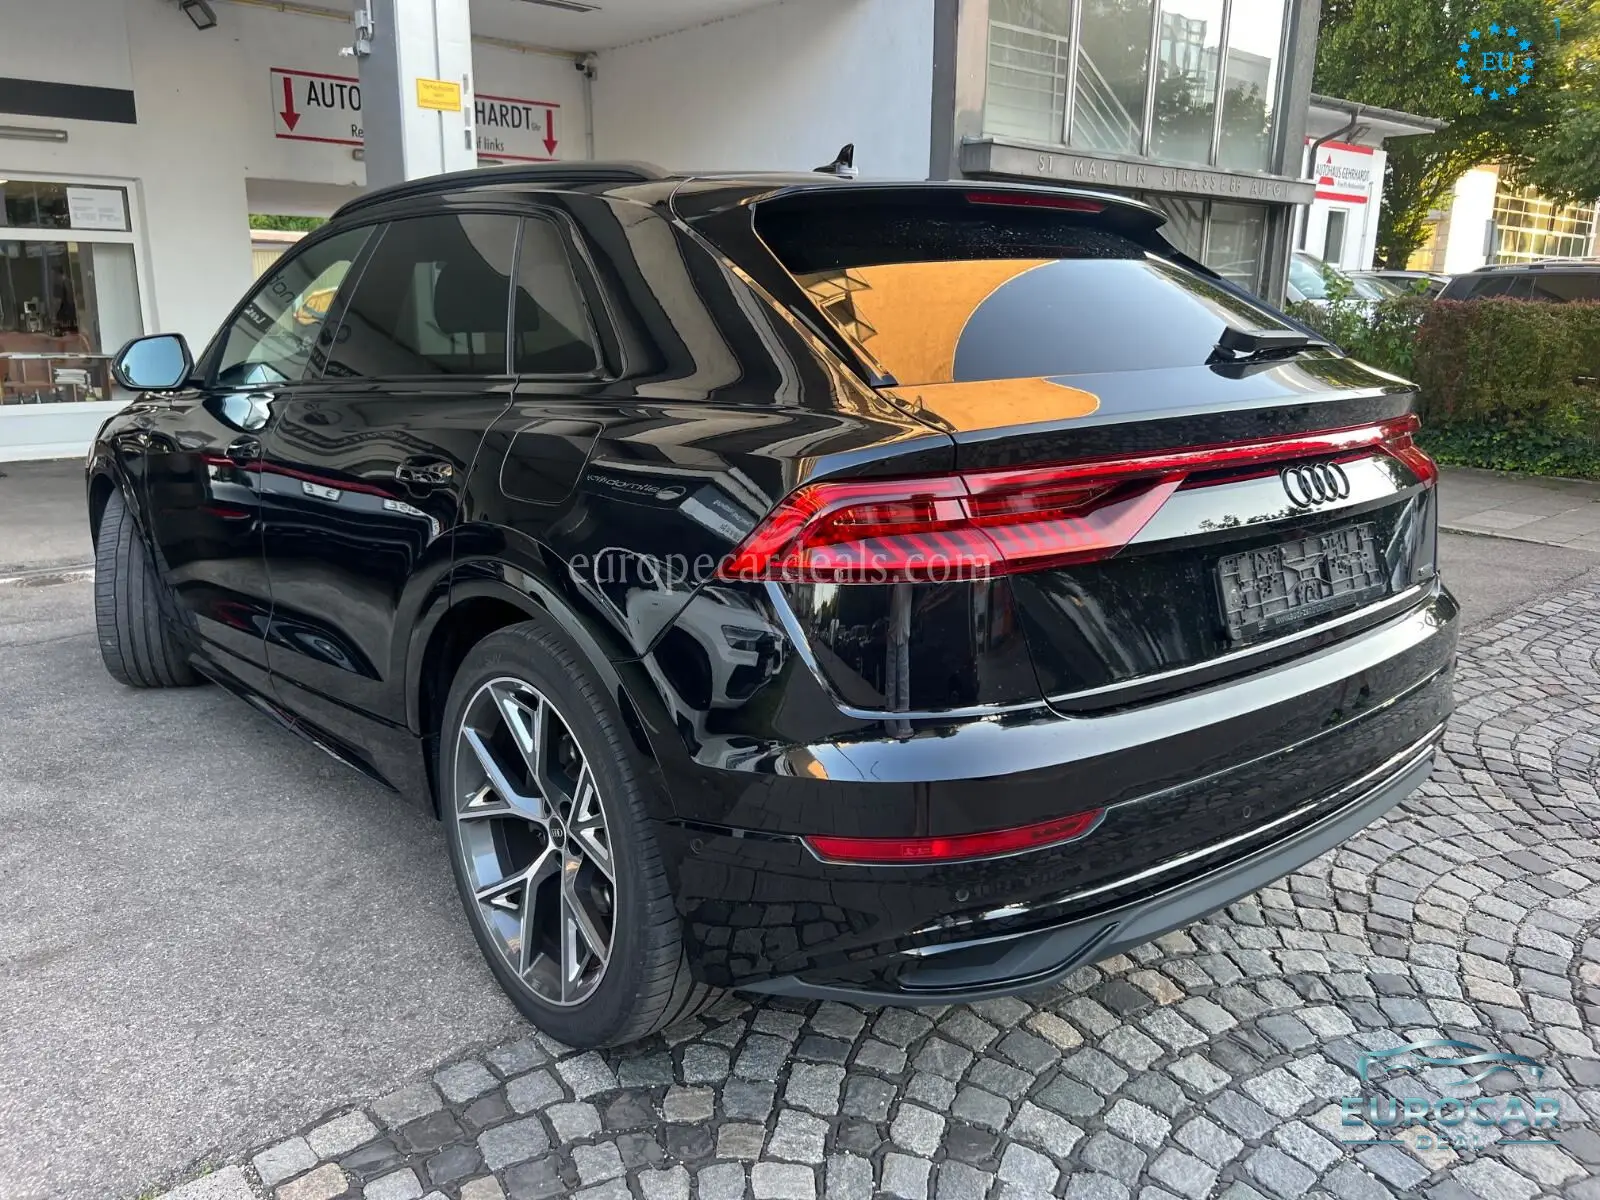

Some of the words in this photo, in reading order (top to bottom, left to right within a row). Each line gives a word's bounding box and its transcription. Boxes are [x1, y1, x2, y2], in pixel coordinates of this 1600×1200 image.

[484, 136, 505, 152] links
[1038, 154, 1053, 173] ST
[1073, 160, 1146, 184] MARTIN
[1316, 163, 1342, 179] AUTOHAUS
